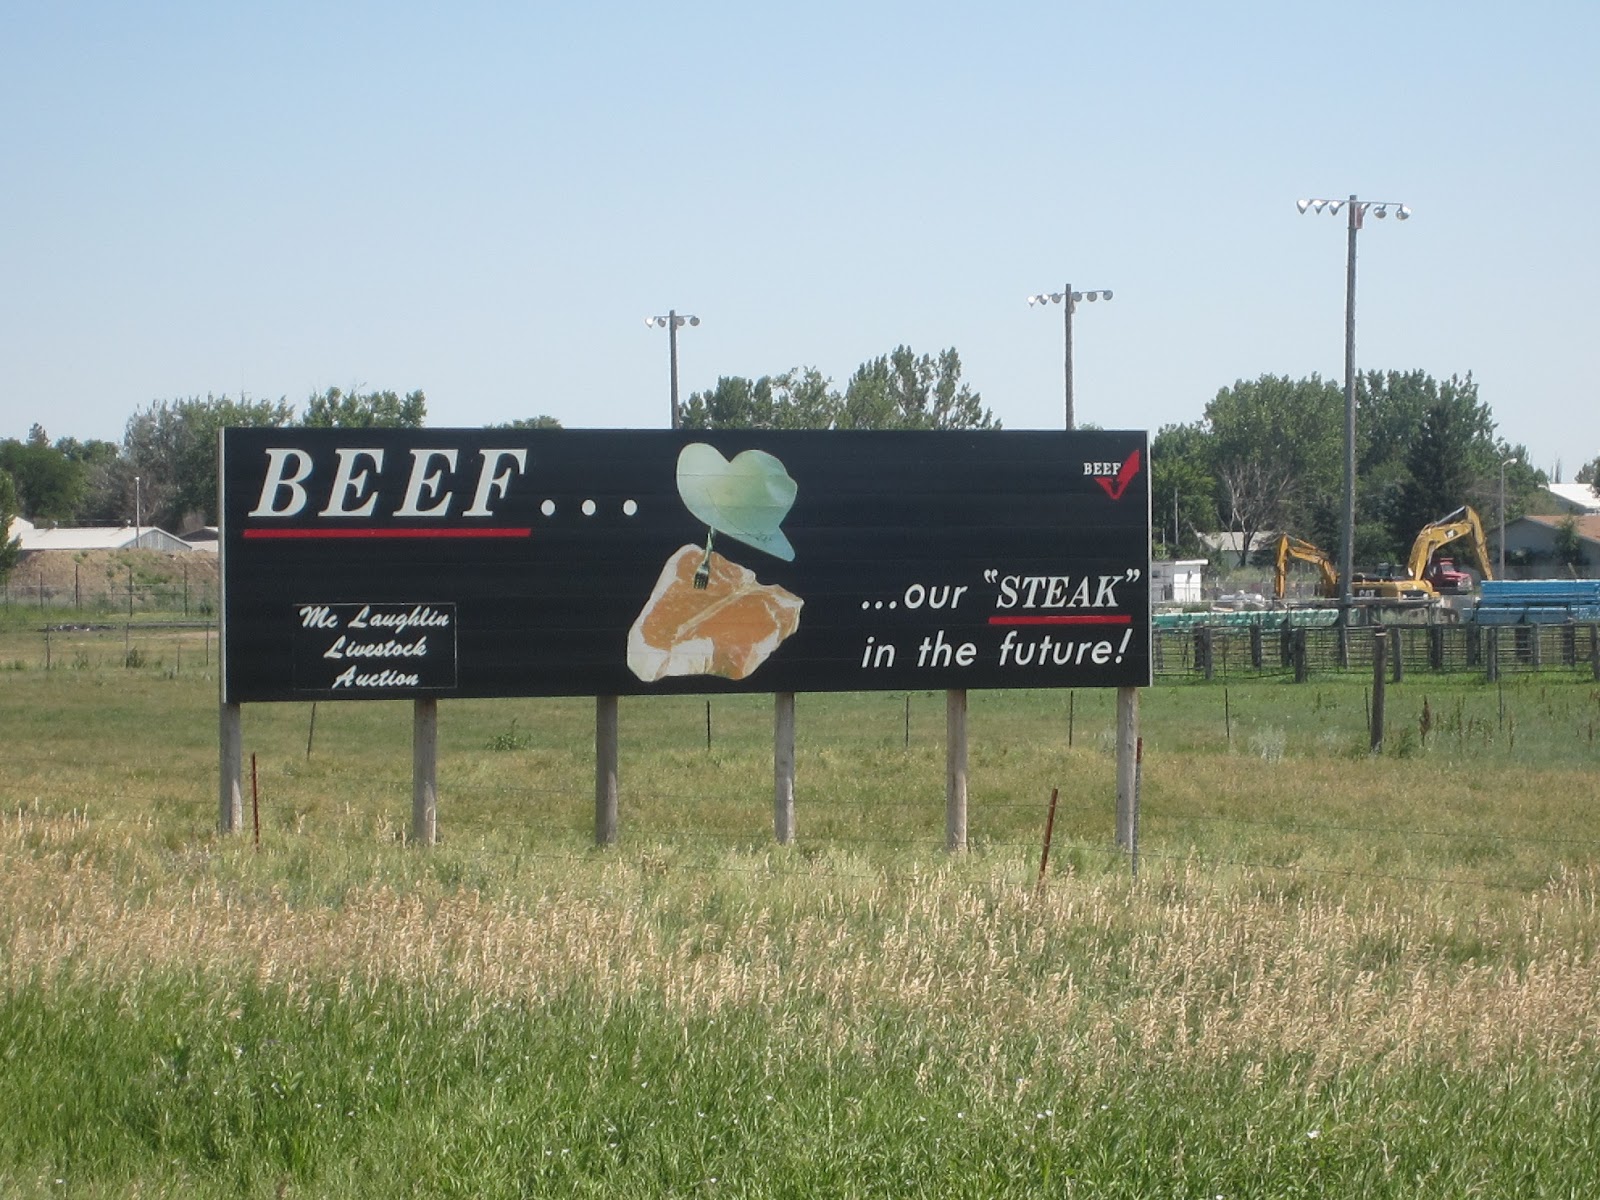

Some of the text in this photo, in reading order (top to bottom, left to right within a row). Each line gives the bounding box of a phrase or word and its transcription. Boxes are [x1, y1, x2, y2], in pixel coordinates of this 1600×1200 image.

[1083, 462, 1121, 475] BEEF
[1358, 589, 1376, 597] CAT
[299, 605, 450, 634] Mc Laughlin
[323, 635, 428, 659] Livestock
[861, 629, 1133, 668] in the future!
[331, 665, 420, 689] Auction
